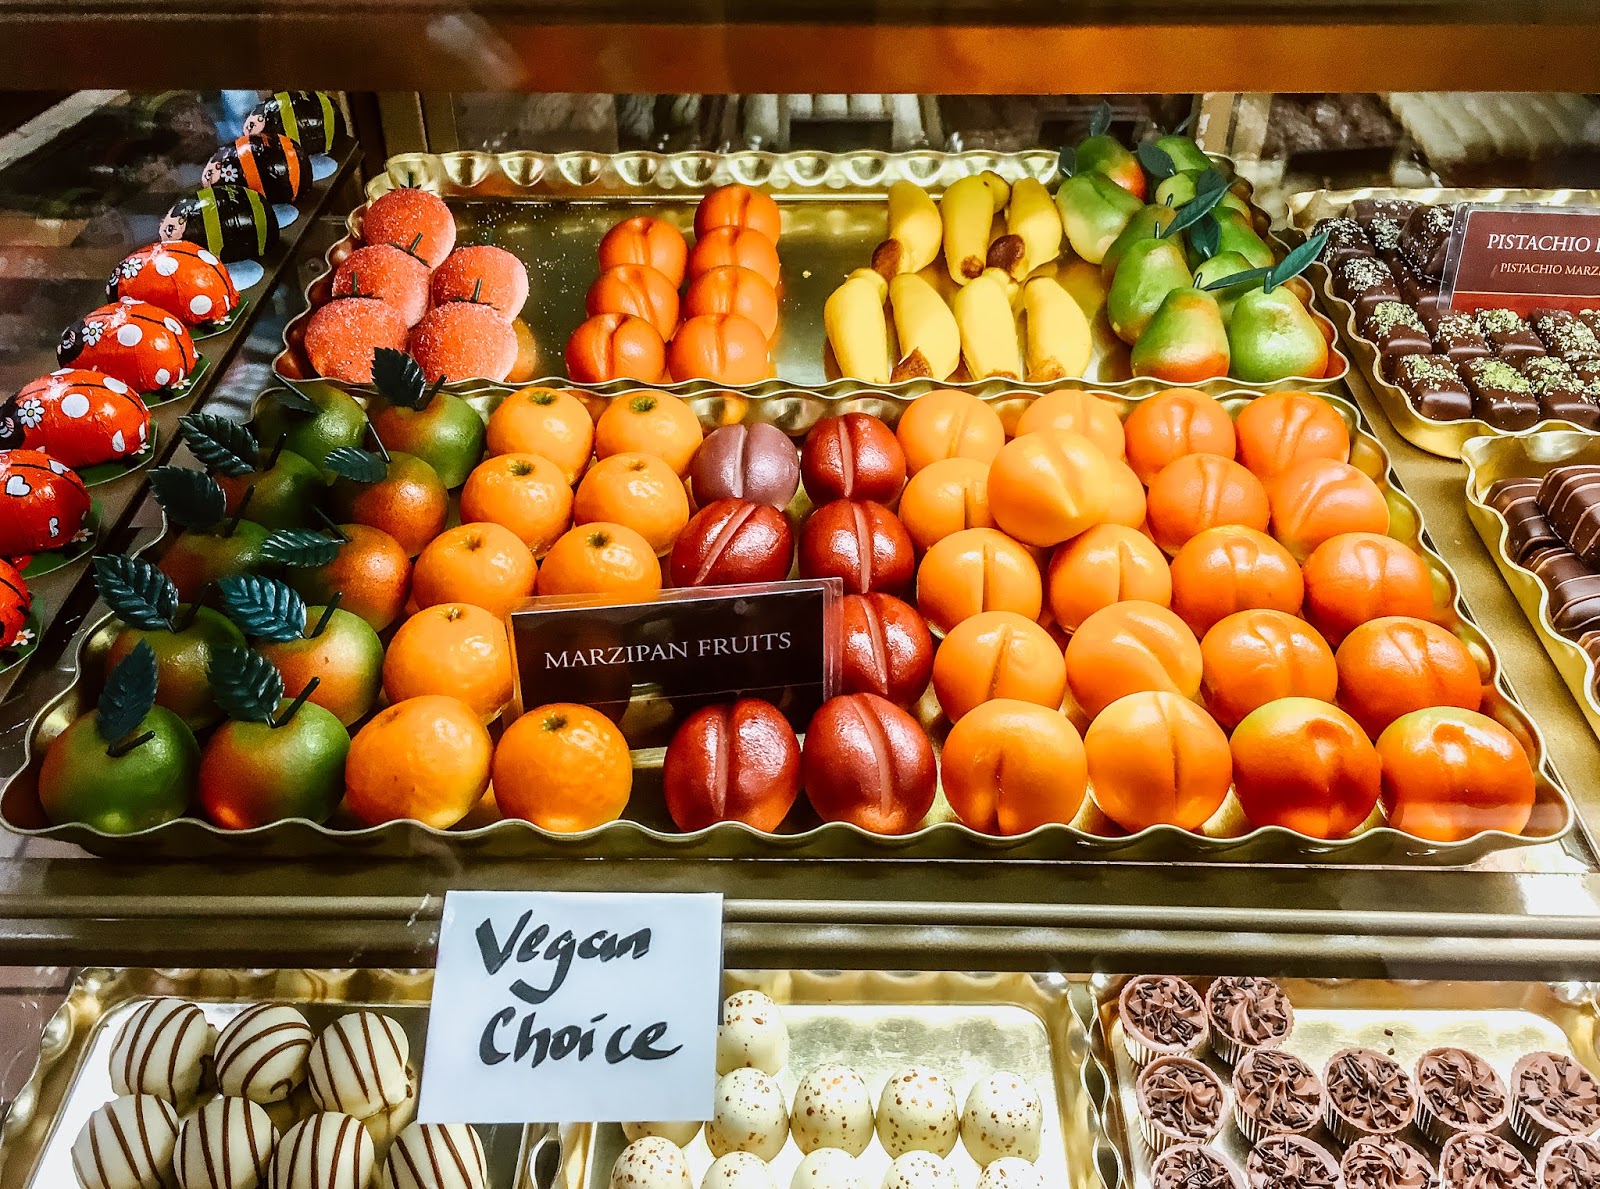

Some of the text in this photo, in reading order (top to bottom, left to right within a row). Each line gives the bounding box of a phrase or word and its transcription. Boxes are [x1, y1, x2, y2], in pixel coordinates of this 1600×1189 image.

[1487, 233, 1591, 252] PISTACHIO
[1500, 262, 1600, 276] PISTACHIO MARZ
[544, 631, 792, 669] MARZIPAN FRUITS
[475, 909, 652, 1005] Vegan
[478, 1006, 684, 1069] Choice
